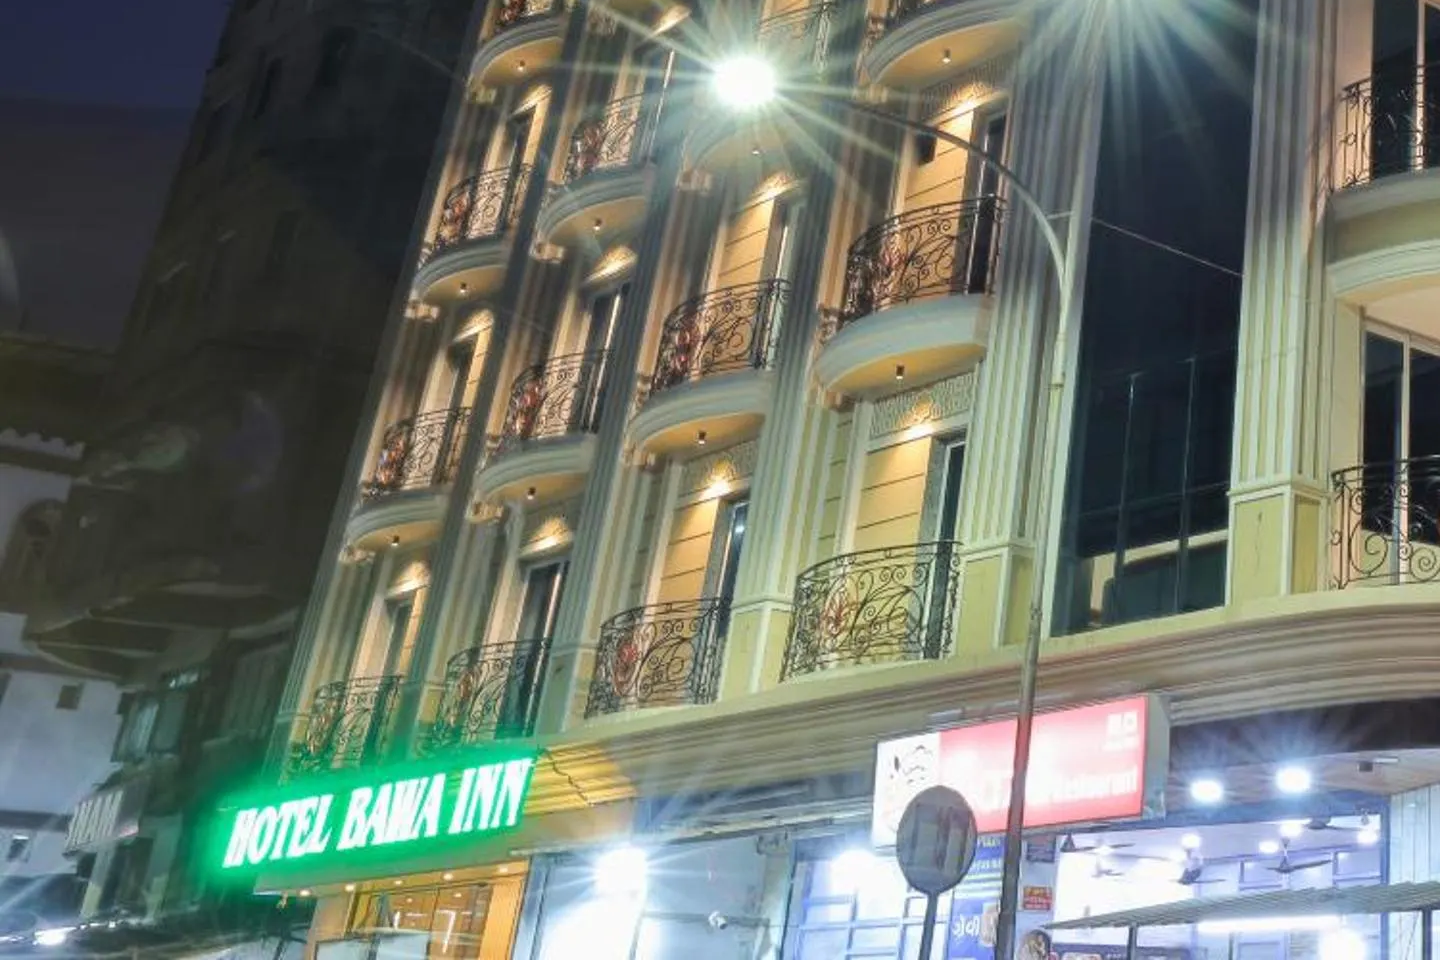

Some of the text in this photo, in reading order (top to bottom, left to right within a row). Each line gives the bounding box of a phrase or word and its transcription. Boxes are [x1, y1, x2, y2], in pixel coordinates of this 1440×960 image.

[222, 757, 535, 868] HOTEL BAWA INN
